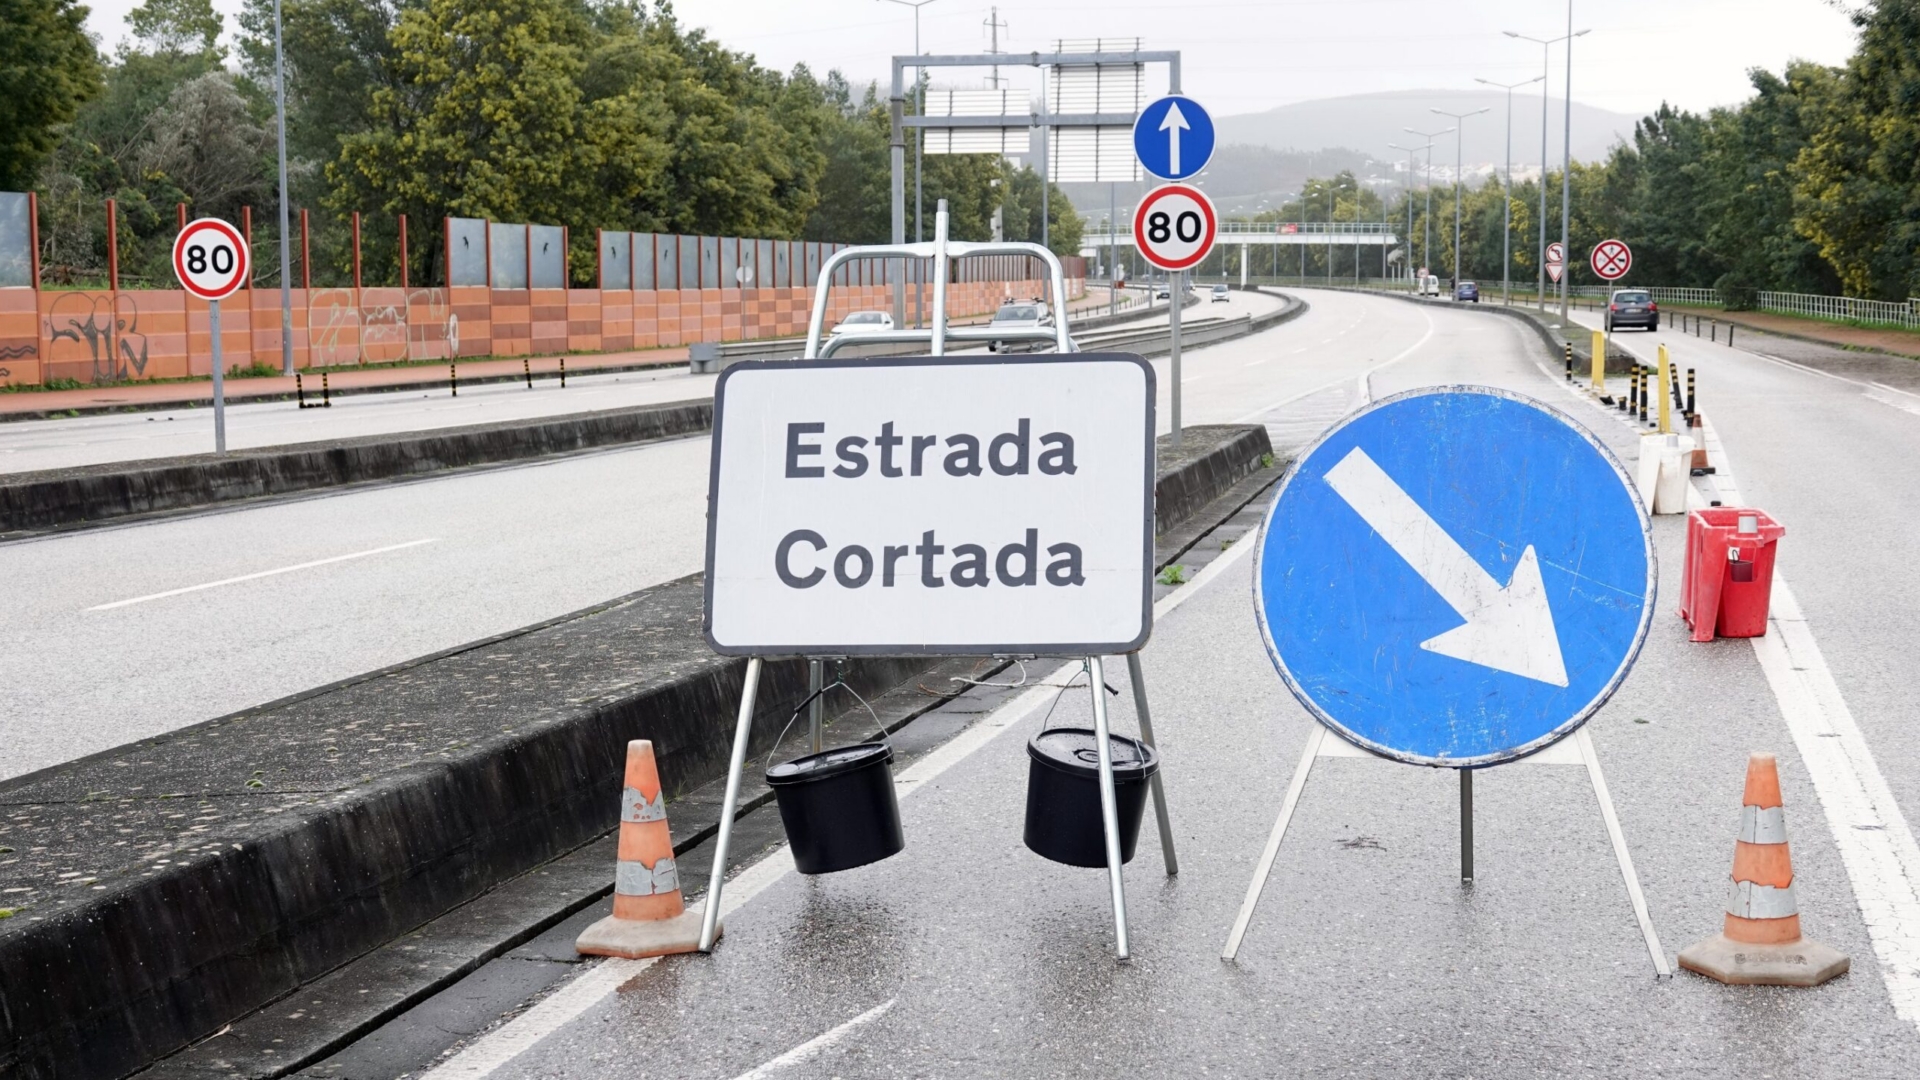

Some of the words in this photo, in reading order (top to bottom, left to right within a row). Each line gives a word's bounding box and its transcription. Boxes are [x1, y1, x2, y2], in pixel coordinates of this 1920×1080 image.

[1148, 211, 1202, 244] 80
[187, 244, 234, 275] 80
[785, 418, 1078, 479] Estrada
[775, 528, 1086, 589] Cortada
